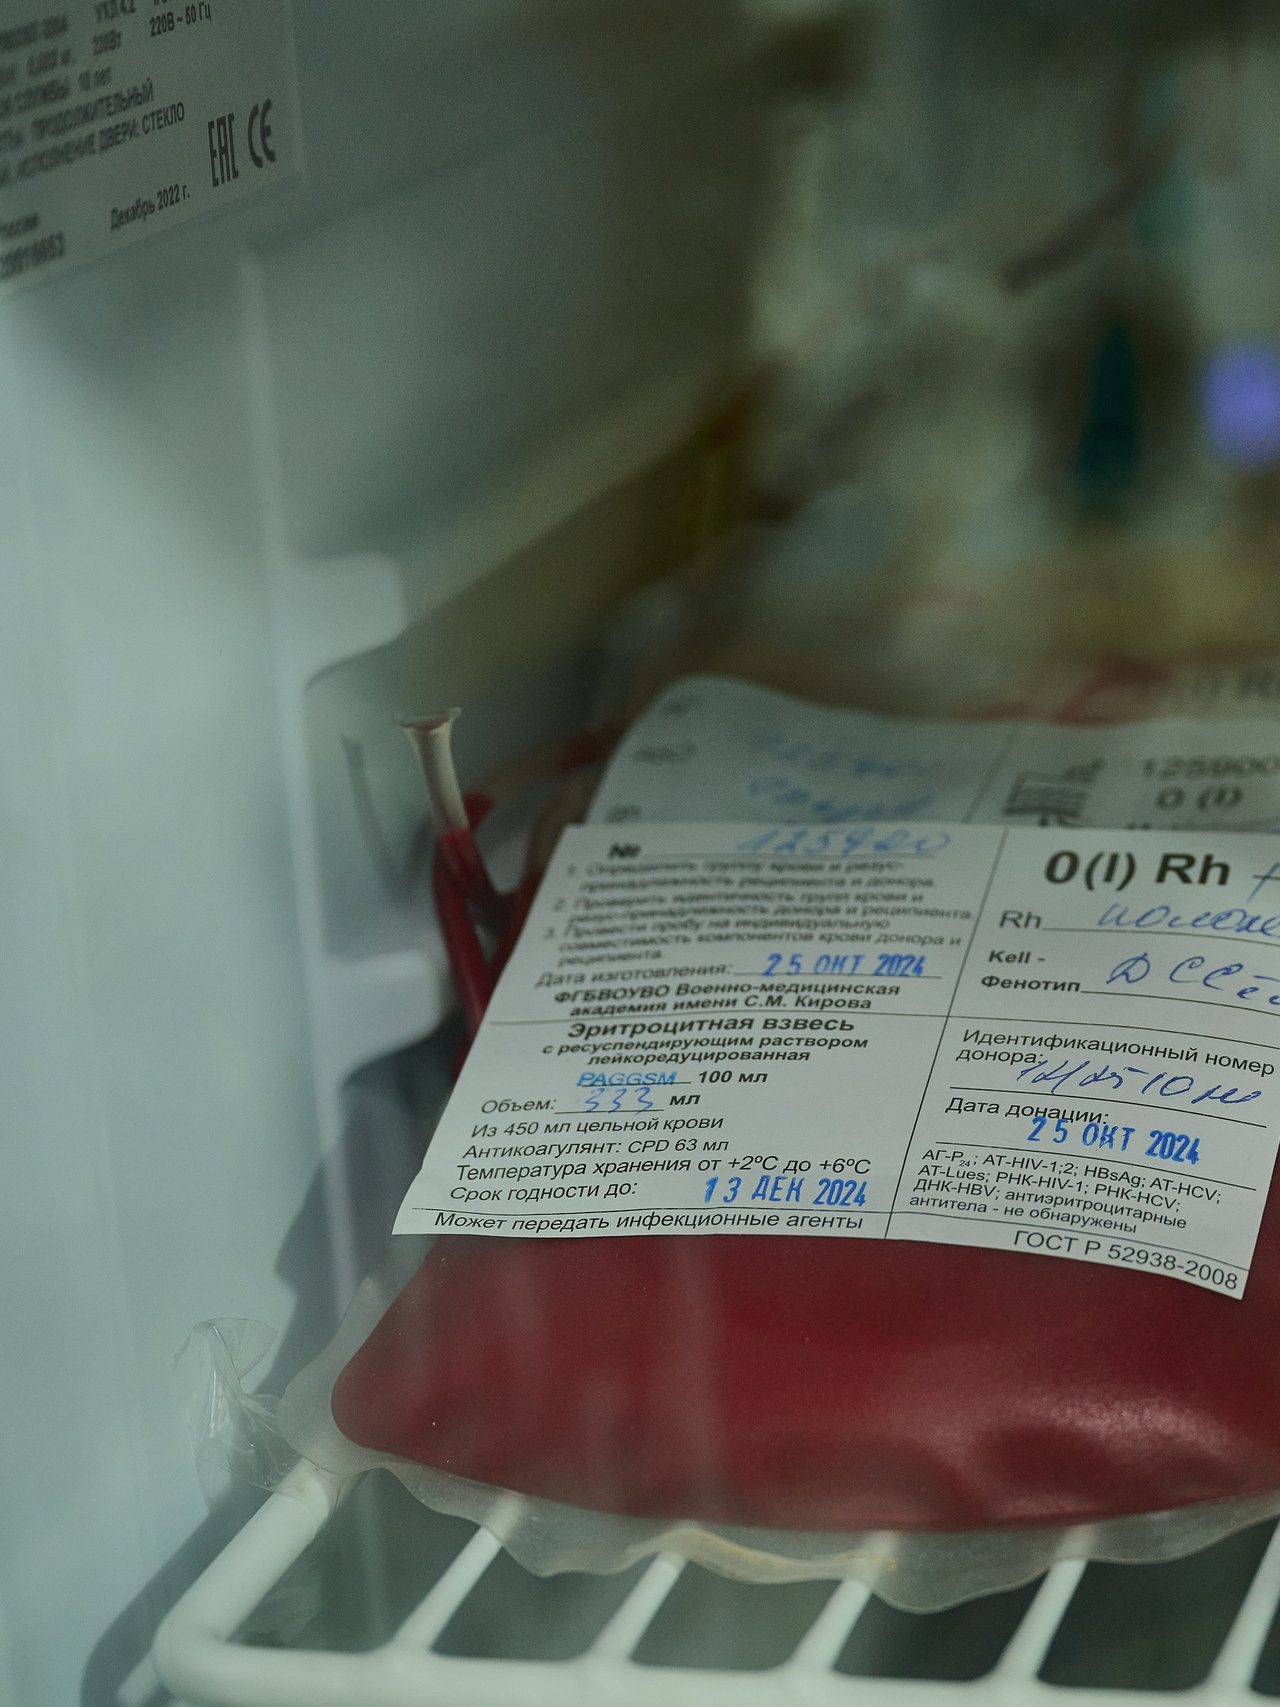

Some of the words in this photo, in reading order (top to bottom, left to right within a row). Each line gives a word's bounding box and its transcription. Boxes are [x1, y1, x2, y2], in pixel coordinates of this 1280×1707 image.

[150, 11, 175, 37] 220В
[185, 5, 197, 25] 50
[198, 2, 212, 22] Гц
[141, 102, 185, 135] СТЕКЛО
[110, 198, 156, 234] Декабрь
[157, 183, 180, 210] 2022
[182, 185, 190, 200] г.
[1155, 852, 1231, 886] Rh
[708, 919, 730, 929] на
[999, 909, 1042, 929] Rh
[697, 931, 814, 943] компонентов
[818, 932, 872, 944] крови
[874, 932, 945, 948] донора
[949, 936, 962, 946] и
[988, 949, 1032, 964] Kell
[535, 970, 586, 989] Дата
[590, 964, 733, 982] изготовления:
[813, 953, 866, 976] ОКТ
[872, 952, 926, 978] 2024
[554, 984, 670, 1004] ФГБВОУВО
[675, 982, 902, 996] Военно-медицинская
[981, 974, 1081, 992] Фенотип
[569, 1000, 668, 1017] академия
[672, 997, 738, 1012] имени
[744, 994, 787, 1008] С.М.
[794, 997, 873, 1011] Кирова
[567, 1017, 755, 1041] Эритроцитная
[762, 1017, 855, 1032] взвесь
[541, 1043, 554, 1055] с
[557, 1036, 754, 1056] ресуспендирующим
[758, 1036, 869, 1050] раствором
[586, 1048, 811, 1066] лейкоредуцированная
[955, 1048, 1044, 1065] донора:
[962, 1029, 1199, 1062] Идентификационный
[1205, 1052, 1275, 1077] номер
[576, 1071, 679, 1088] PAGGSM
[698, 1069, 733, 1084] 100
[738, 1071, 769, 1084] мл
[481, 1098, 557, 1114] Объем:
[669, 1094, 701, 1106] мл
[945, 1097, 1000, 1114] Дата
[1004, 1103, 1110, 1125] донации:
[471, 1124, 498, 1138] Из
[503, 1121, 540, 1136] 450
[544, 1122, 571, 1134] мл
[576, 1118, 660, 1135] цельной
[663, 1117, 724, 1133] крови
[462, 1141, 622, 1159] Антикоагулянт:
[627, 1140, 670, 1154] CPD
[674, 1138, 697, 1152] 63
[702, 1140, 729, 1152] мл
[1081, 1122, 1136, 1151] ОКТ
[1145, 1129, 1201, 1165] 2024
[456, 1162, 587, 1182] Температура
[592, 1159, 691, 1178] хранения
[697, 1159, 722, 1171] от
[782, 1159, 811, 1174] до
[982, 1154, 1079, 1176] АТ-HIV-1;2;
[1084, 1165, 1146, 1188] HBsAg;
[1150, 1177, 1221, 1204] АТ-HCV;
[450, 1186, 503, 1203] Срок
[507, 1184, 600, 1202] годности
[604, 1182, 638, 1199] до:
[751, 1175, 806, 1203] ДЕК
[812, 1177, 868, 1207] 2024
[918, 1164, 991, 1183] АТ-Lues;
[995, 1171, 1089, 1195] РНК-HIV-1;
[1094, 1183, 1181, 1213] РНК-HCV;
[909, 1196, 987, 1213] антитела
[1003, 1206, 1024, 1217] не
[1029, 1206, 1137, 1233] обнаружены
[913, 1178, 1001, 1200] ДНК-HBV;
[1005, 1190, 1187, 1229] антиэритроцитарные
[434, 1211, 508, 1230] Может
[511, 1216, 610, 1234] передать
[616, 1211, 780, 1232] инфекционные
[786, 1215, 863, 1229] агенты
[1014, 1230, 1079, 1252] ГОСТ
[1085, 1240, 1101, 1255] Р
[1107, 1243, 1239, 1290] 52938-2008
